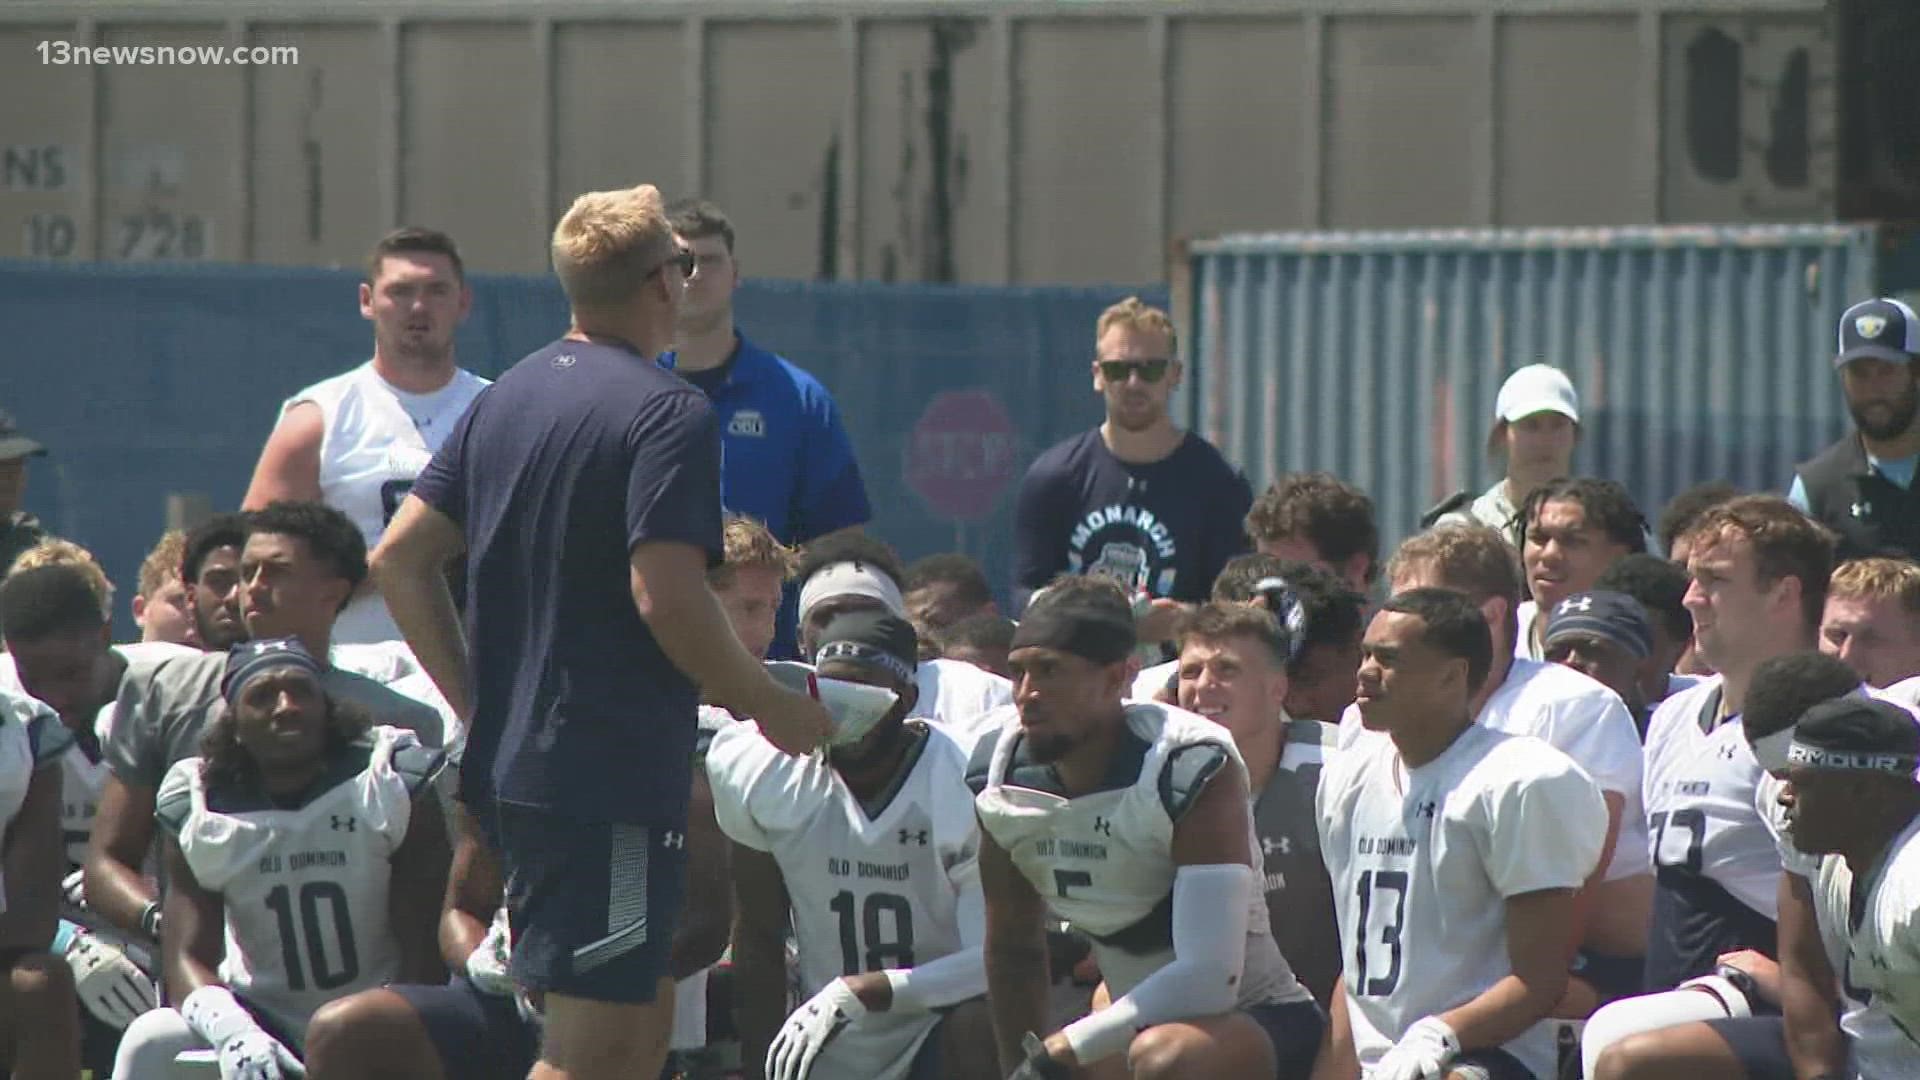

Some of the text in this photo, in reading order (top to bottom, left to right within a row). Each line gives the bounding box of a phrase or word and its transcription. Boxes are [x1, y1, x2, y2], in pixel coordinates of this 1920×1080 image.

[1070, 503, 1177, 558] MONARCH
[828, 857, 910, 882] OLD DOMINION
[264, 880, 359, 991] 10
[830, 889, 915, 977] 18
[1356, 869, 1409, 996] 13
